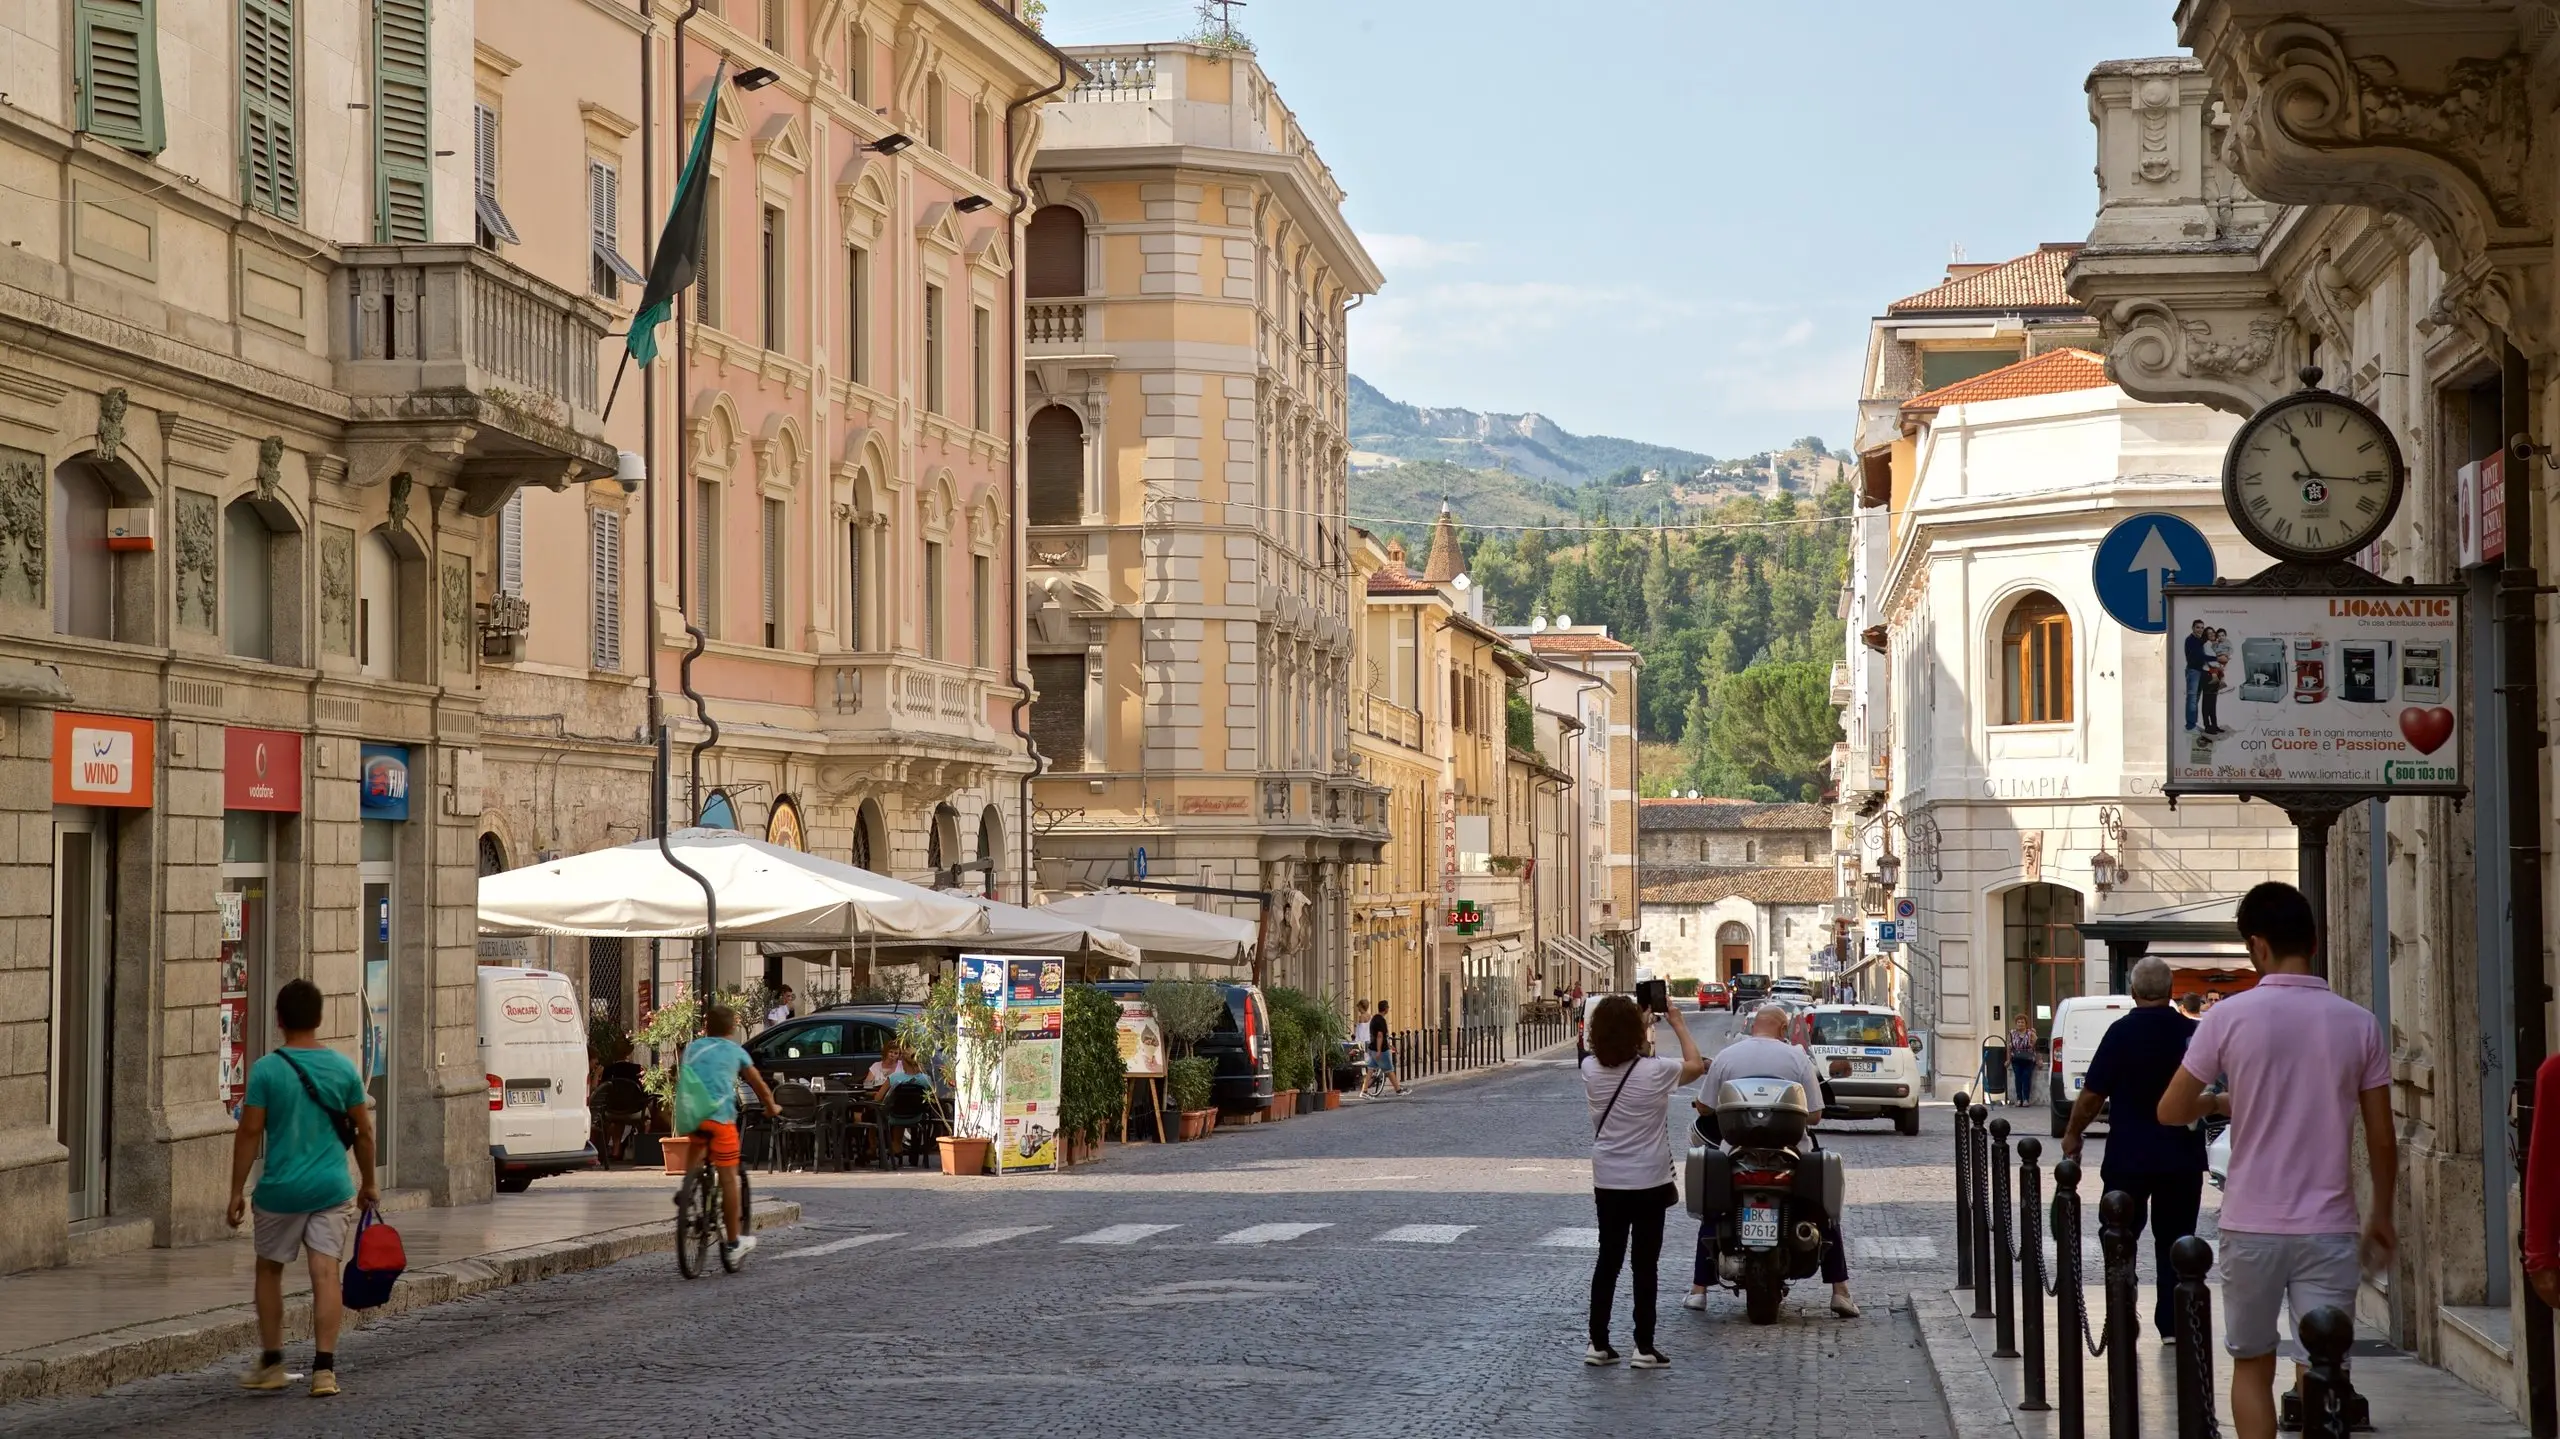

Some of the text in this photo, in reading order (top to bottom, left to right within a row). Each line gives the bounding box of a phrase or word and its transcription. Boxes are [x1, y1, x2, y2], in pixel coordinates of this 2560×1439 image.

[2329, 599, 2450, 617] LIOMATIC
[2358, 619, 2371, 627] Chi
[2261, 727, 2393, 740] Vicini a Te in ogni momento
[2241, 737, 2406, 751] con Cuore e Passione
[84, 762, 118, 785] WIND
[2184, 767, 2214, 777] Caffè
[2288, 768, 2370, 780] www.liomatic.it
[2396, 767, 2456, 780] 800 103 010
[388, 769, 405, 798] TIM
[1983, 777, 2070, 798] OLIMPIA
[249, 784, 274, 799] vodafone
[1444, 792, 1455, 927] FARMACIA
[1884, 926, 1894, 938] P
[1751, 1209, 1764, 1222] BK
[1744, 1224, 1776, 1237] 87612
